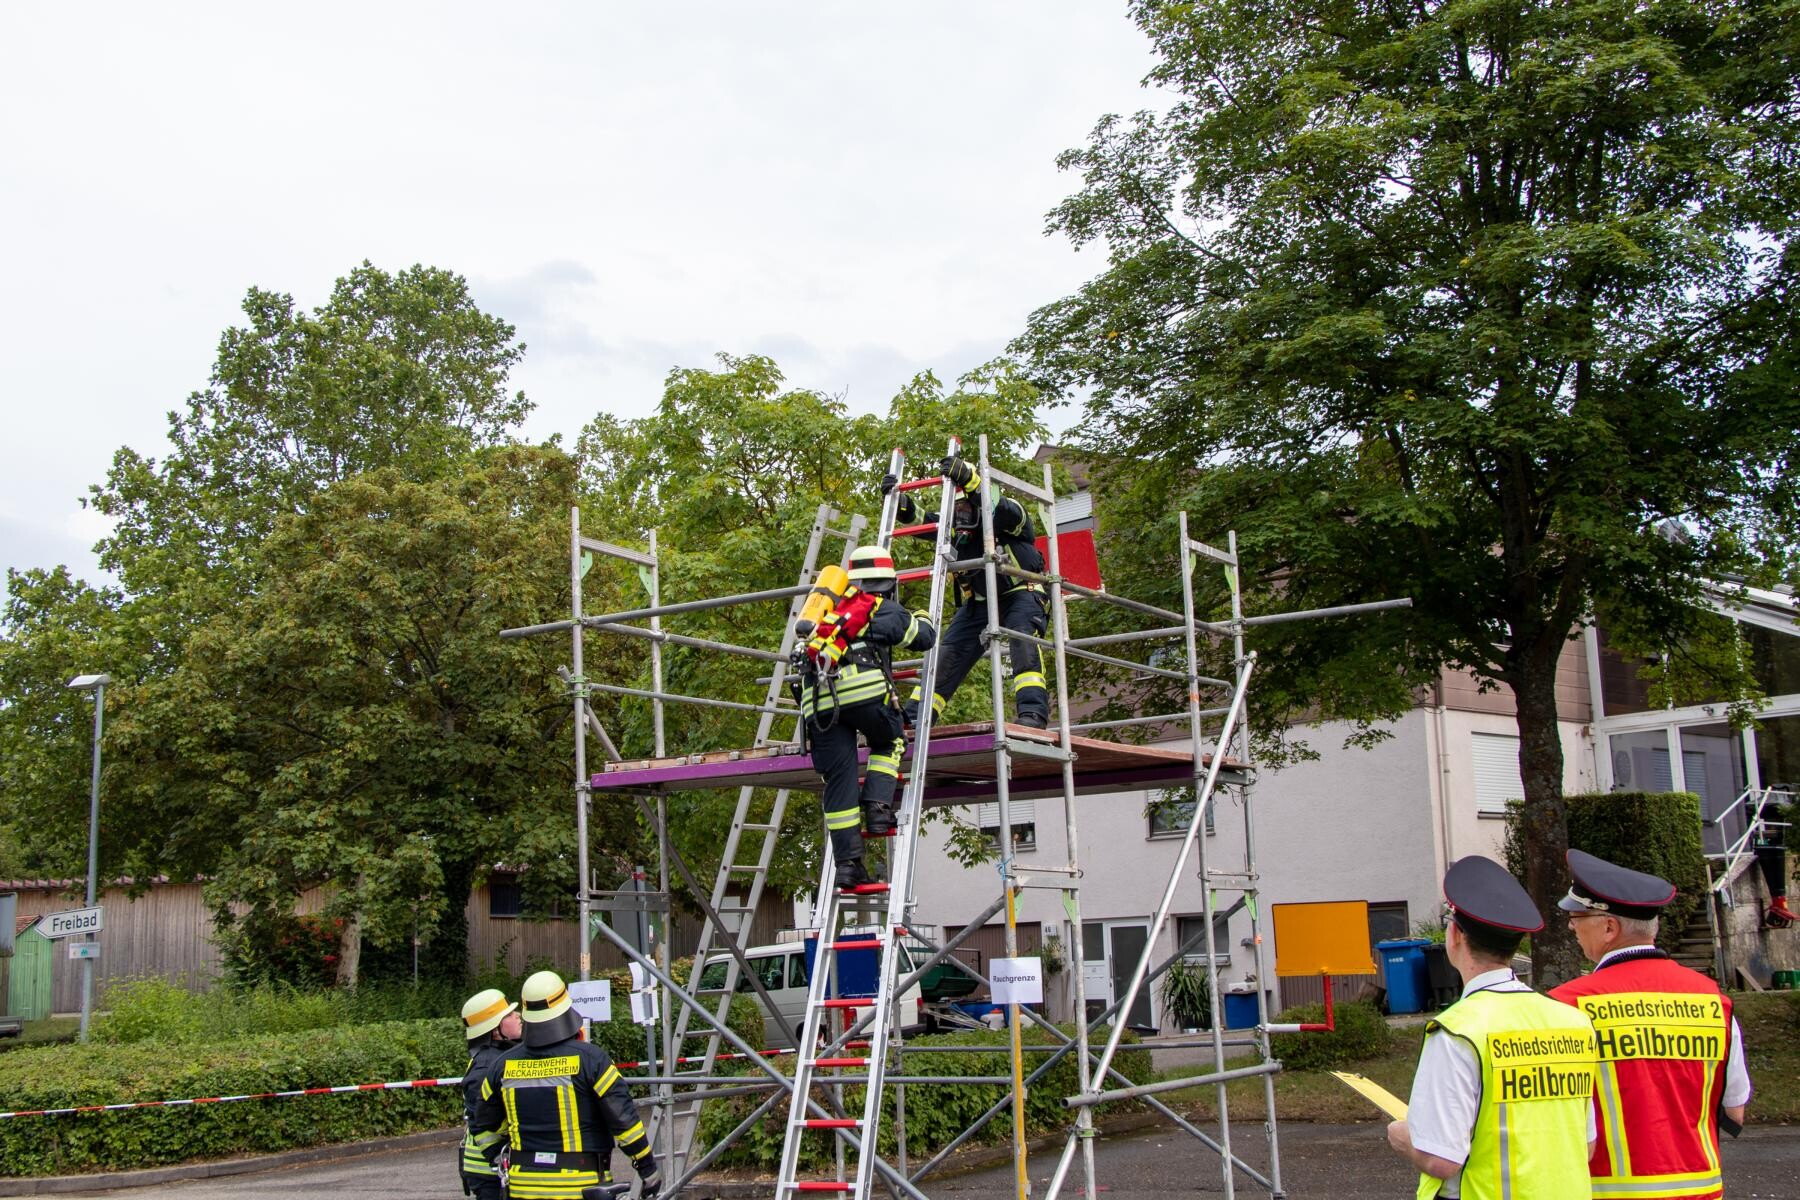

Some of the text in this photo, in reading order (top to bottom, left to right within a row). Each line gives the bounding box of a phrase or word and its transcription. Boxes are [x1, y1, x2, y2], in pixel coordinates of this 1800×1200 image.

[52, 912, 97, 931] Freibad
[993, 975, 1035, 983] Rauchgrenze
[1584, 999, 1721, 1021] Schiedsrichter 2
[1492, 1036, 1585, 1059] Schiedsrichter
[1595, 1027, 1718, 1059] Heilbronn
[506, 1066, 578, 1077] NECKARWESTHEIM
[518, 1058, 567, 1068] FEUERWEHR
[1501, 1066, 1591, 1100] Heilbronn
